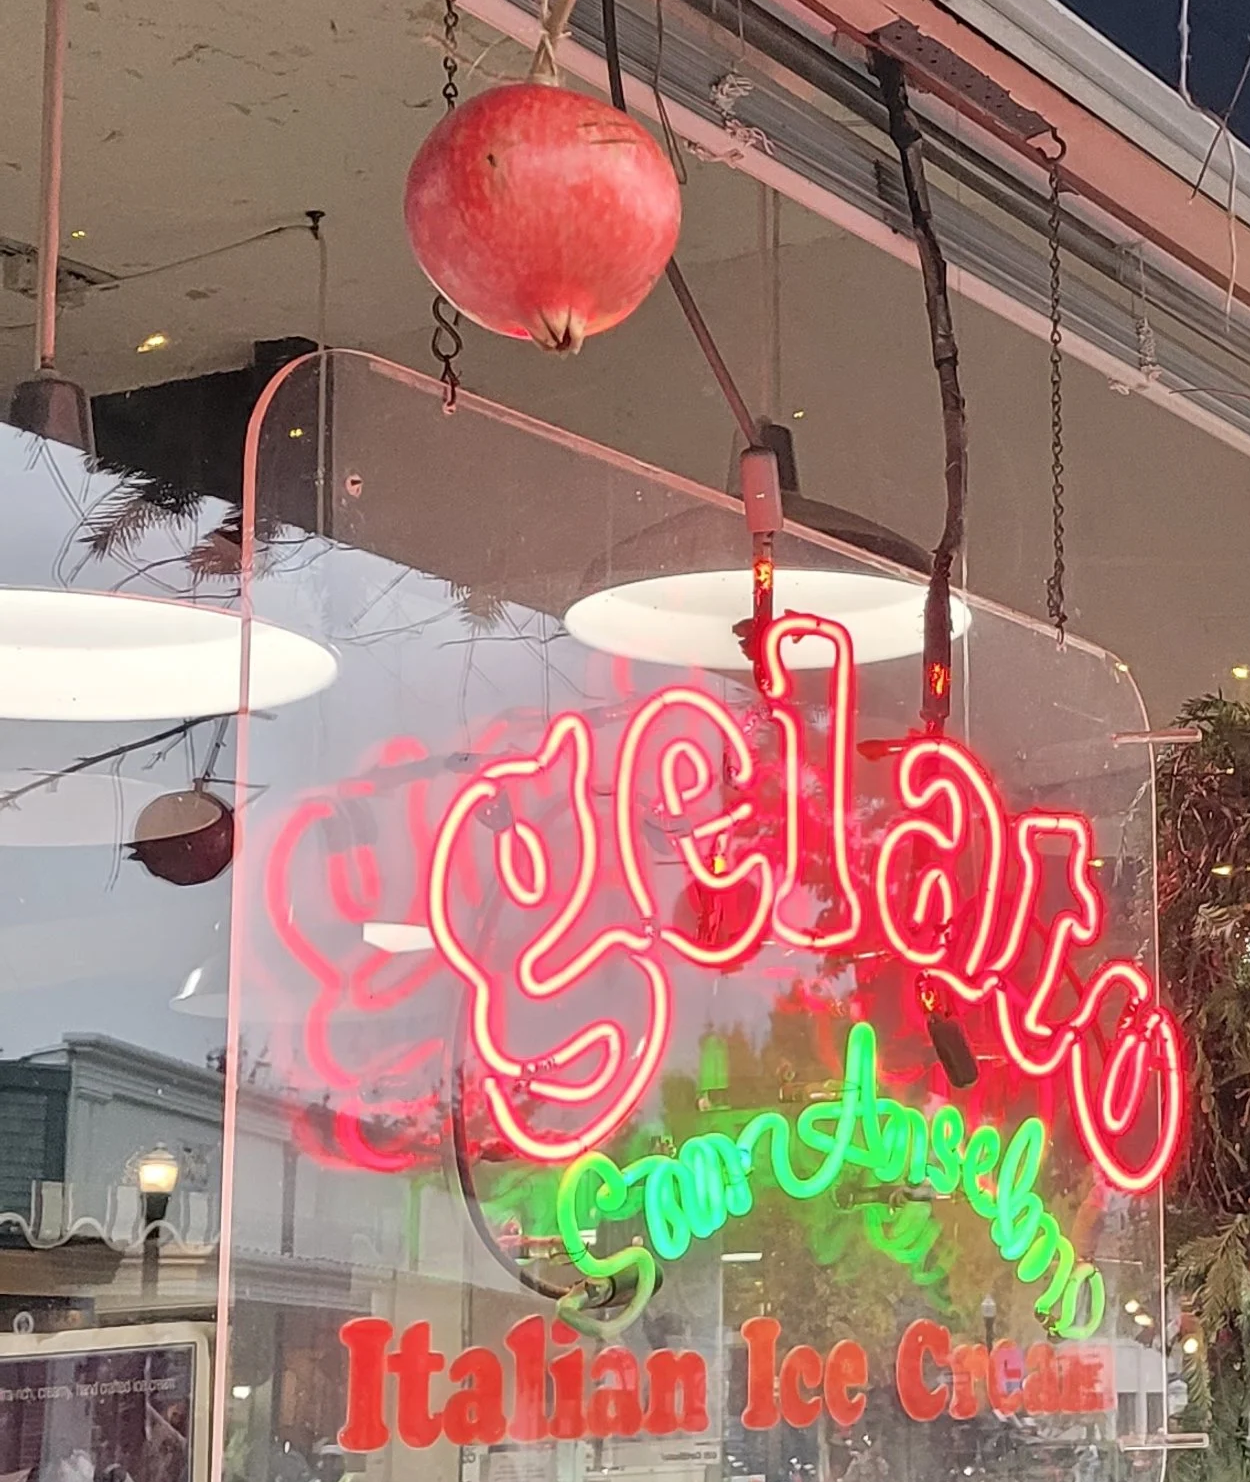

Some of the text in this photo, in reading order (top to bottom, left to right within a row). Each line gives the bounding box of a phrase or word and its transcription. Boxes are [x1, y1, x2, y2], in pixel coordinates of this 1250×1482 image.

[430, 614, 1182, 1191] gelato
[557, 1023, 1105, 1339] San Anselmo
[339, 1316, 1114, 1453] Italian Ice Cream
